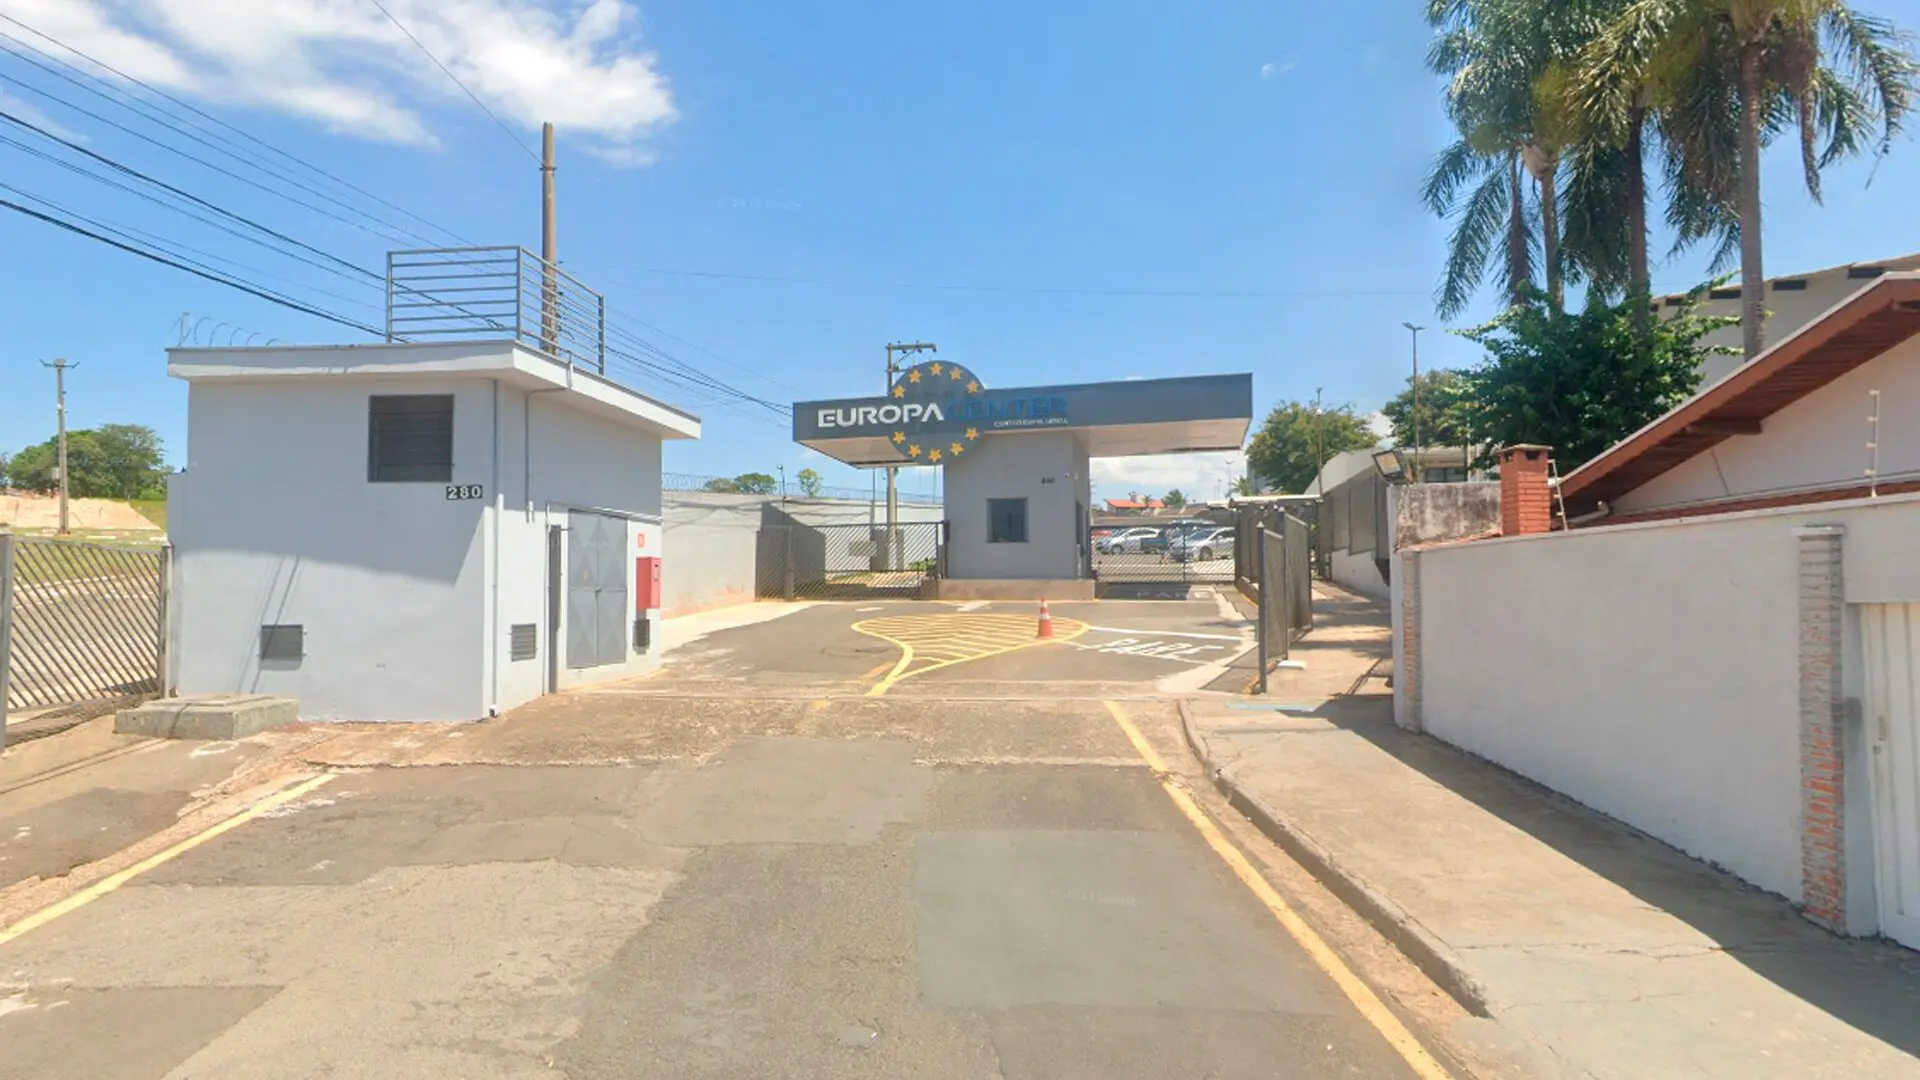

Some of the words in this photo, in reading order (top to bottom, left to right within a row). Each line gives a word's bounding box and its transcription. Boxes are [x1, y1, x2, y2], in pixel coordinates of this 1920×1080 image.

[817, 403, 944, 428] EUROPA
[946, 396, 1068, 420] CENTER
[447, 485, 482, 500] 280
